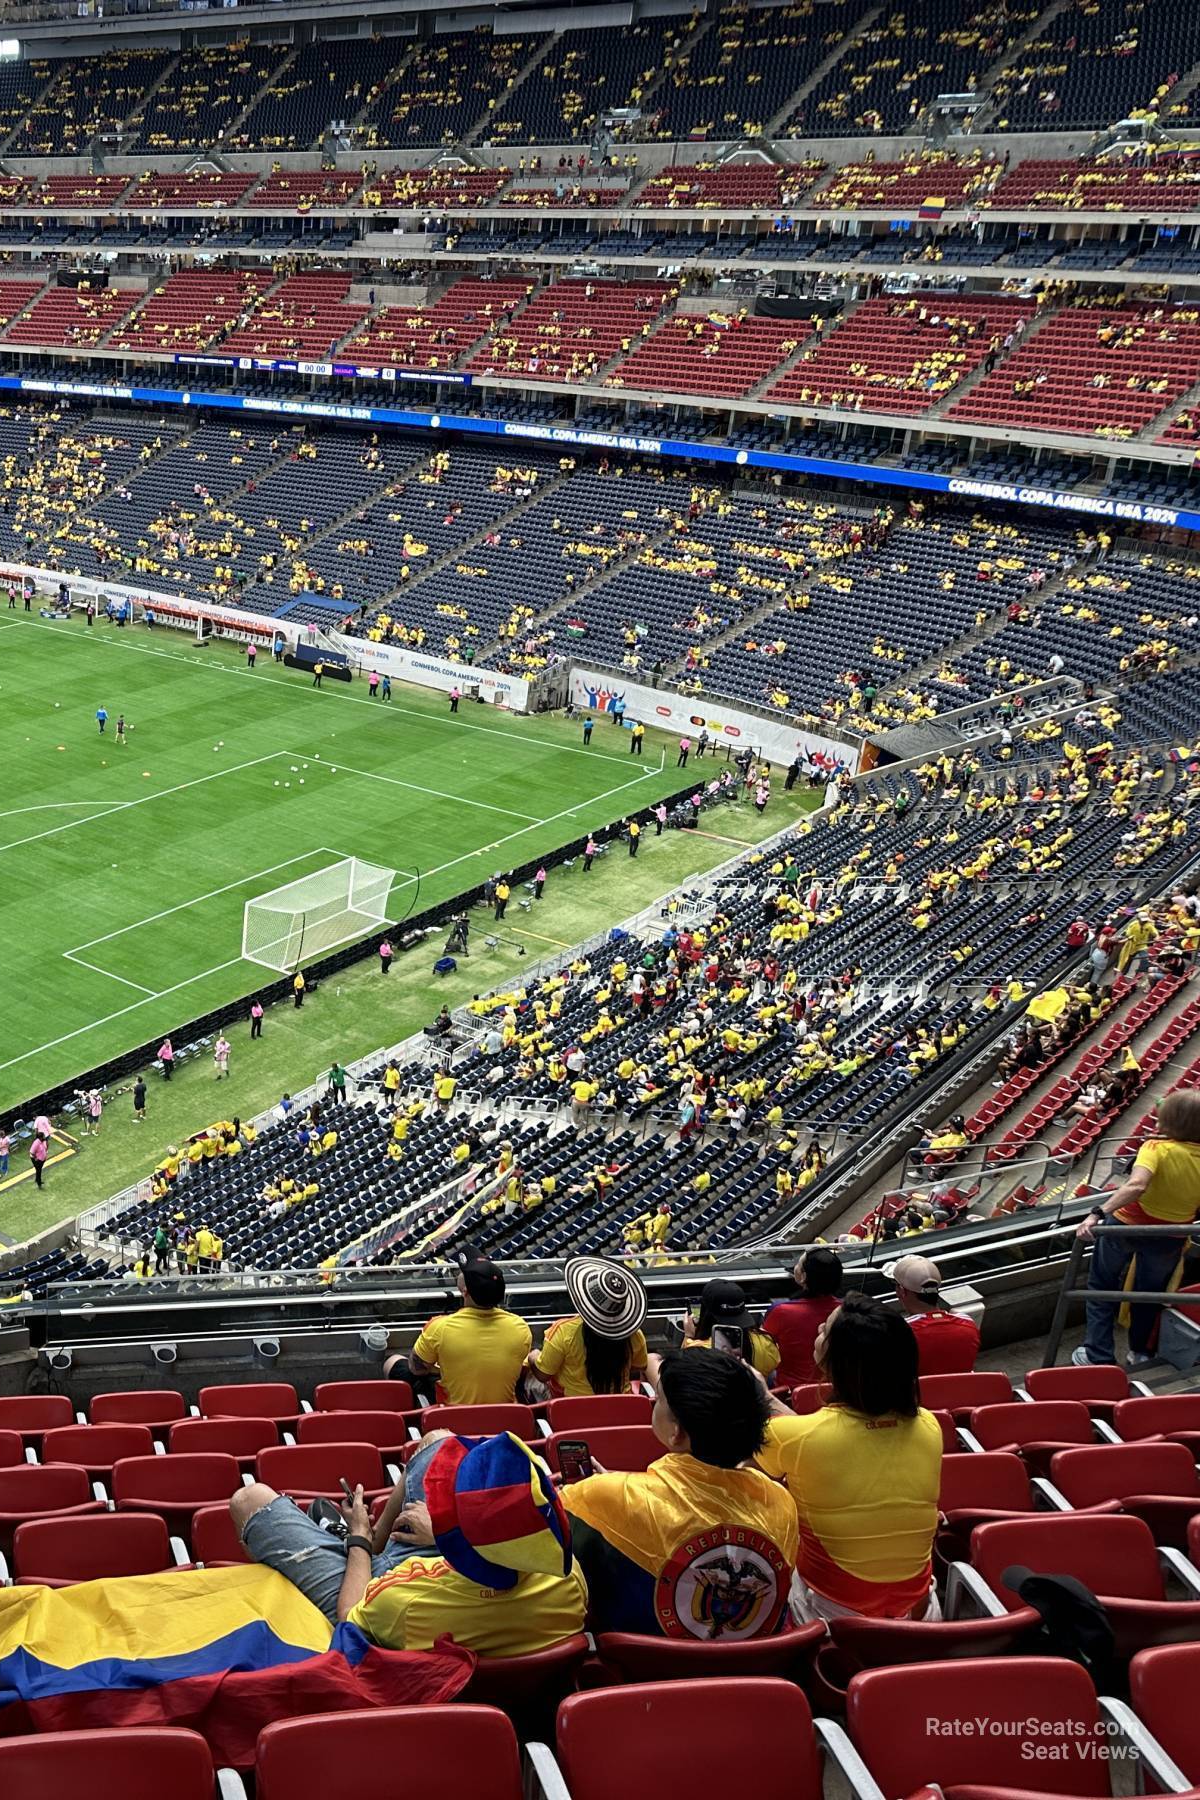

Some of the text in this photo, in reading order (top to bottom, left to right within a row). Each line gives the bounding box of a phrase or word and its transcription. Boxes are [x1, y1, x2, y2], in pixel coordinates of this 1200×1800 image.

[505, 423, 662, 452] CONMEBOL COPA AMERICA USA 2024
[949, 479, 1179, 525] CONMEBOL COPA AMERICA USA 2024
[365, 648, 375, 656] USA
[377, 651, 390, 660] 2024
[411, 660, 511, 691] CONMEBOL COPA AMERICA USA 2024
[684, 1529, 784, 1571] REPUBLICA
[661, 1608, 677, 1628] DE
